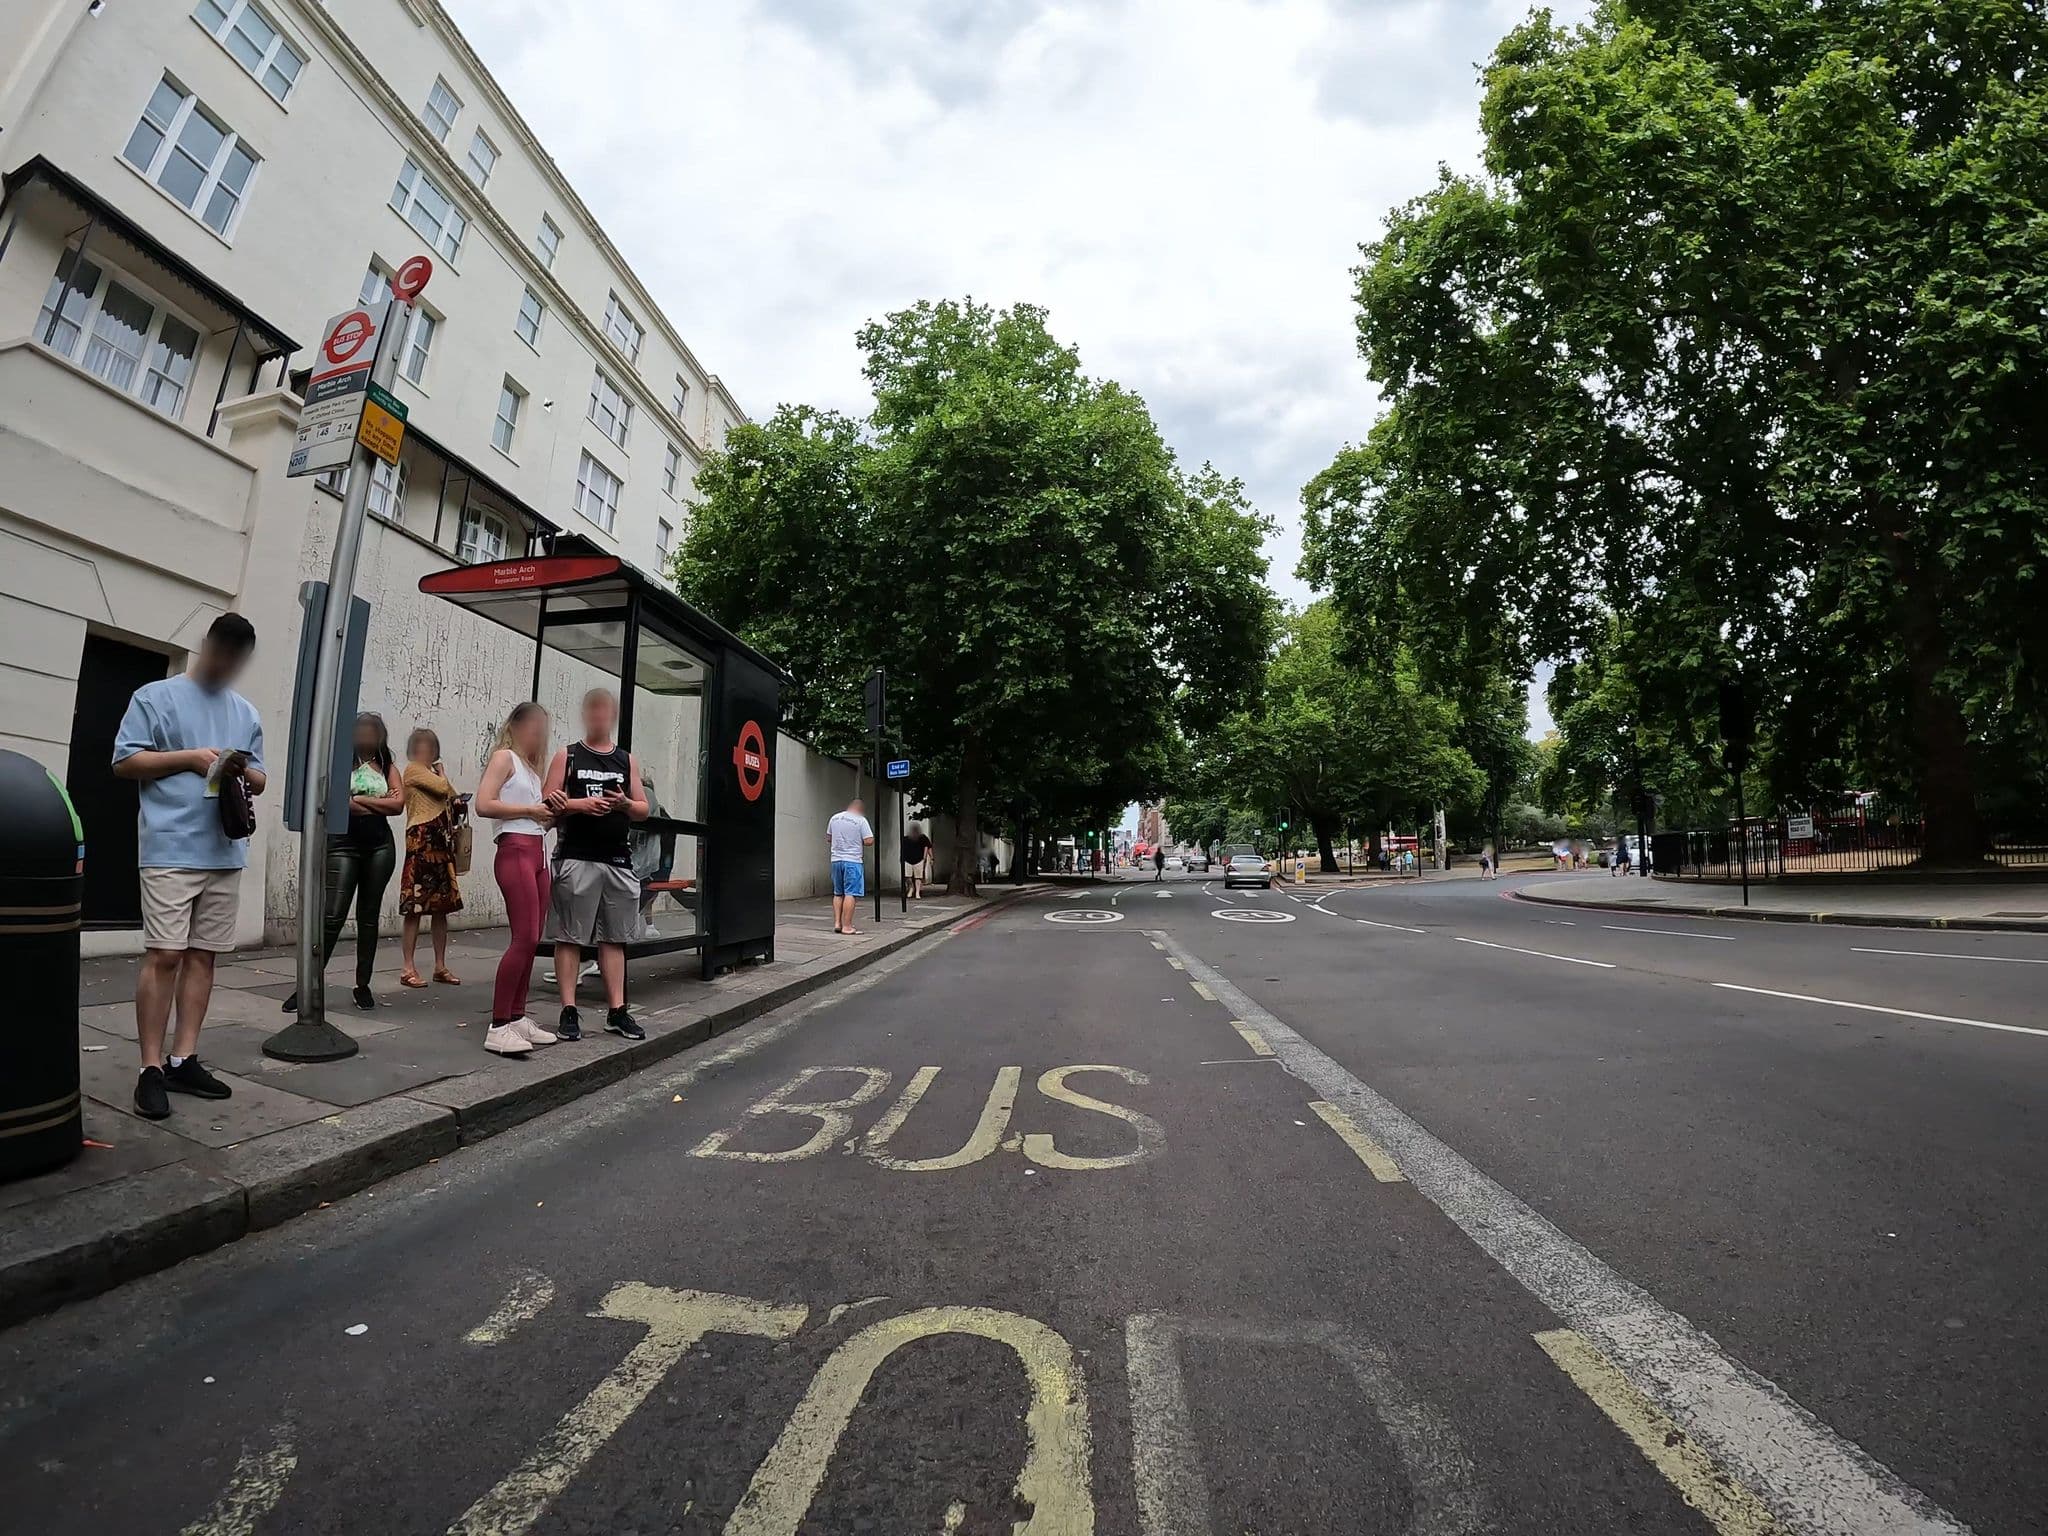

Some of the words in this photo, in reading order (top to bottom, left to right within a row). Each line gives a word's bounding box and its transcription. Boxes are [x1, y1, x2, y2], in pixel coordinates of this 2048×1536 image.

[399, 262, 424, 290] C
[333, 336, 346, 345] BUS
[346, 330, 364, 341] STOP
[337, 375, 352, 385] Arch
[316, 427, 329, 438] 148
[337, 422, 352, 433] 274
[494, 567, 518, 577] Marble
[518, 564, 536, 574] Arch
[745, 753, 760, 768] BUSES
[577, 769, 624, 783] RAIDERS
[686, 1063, 1167, 1173] BUS
